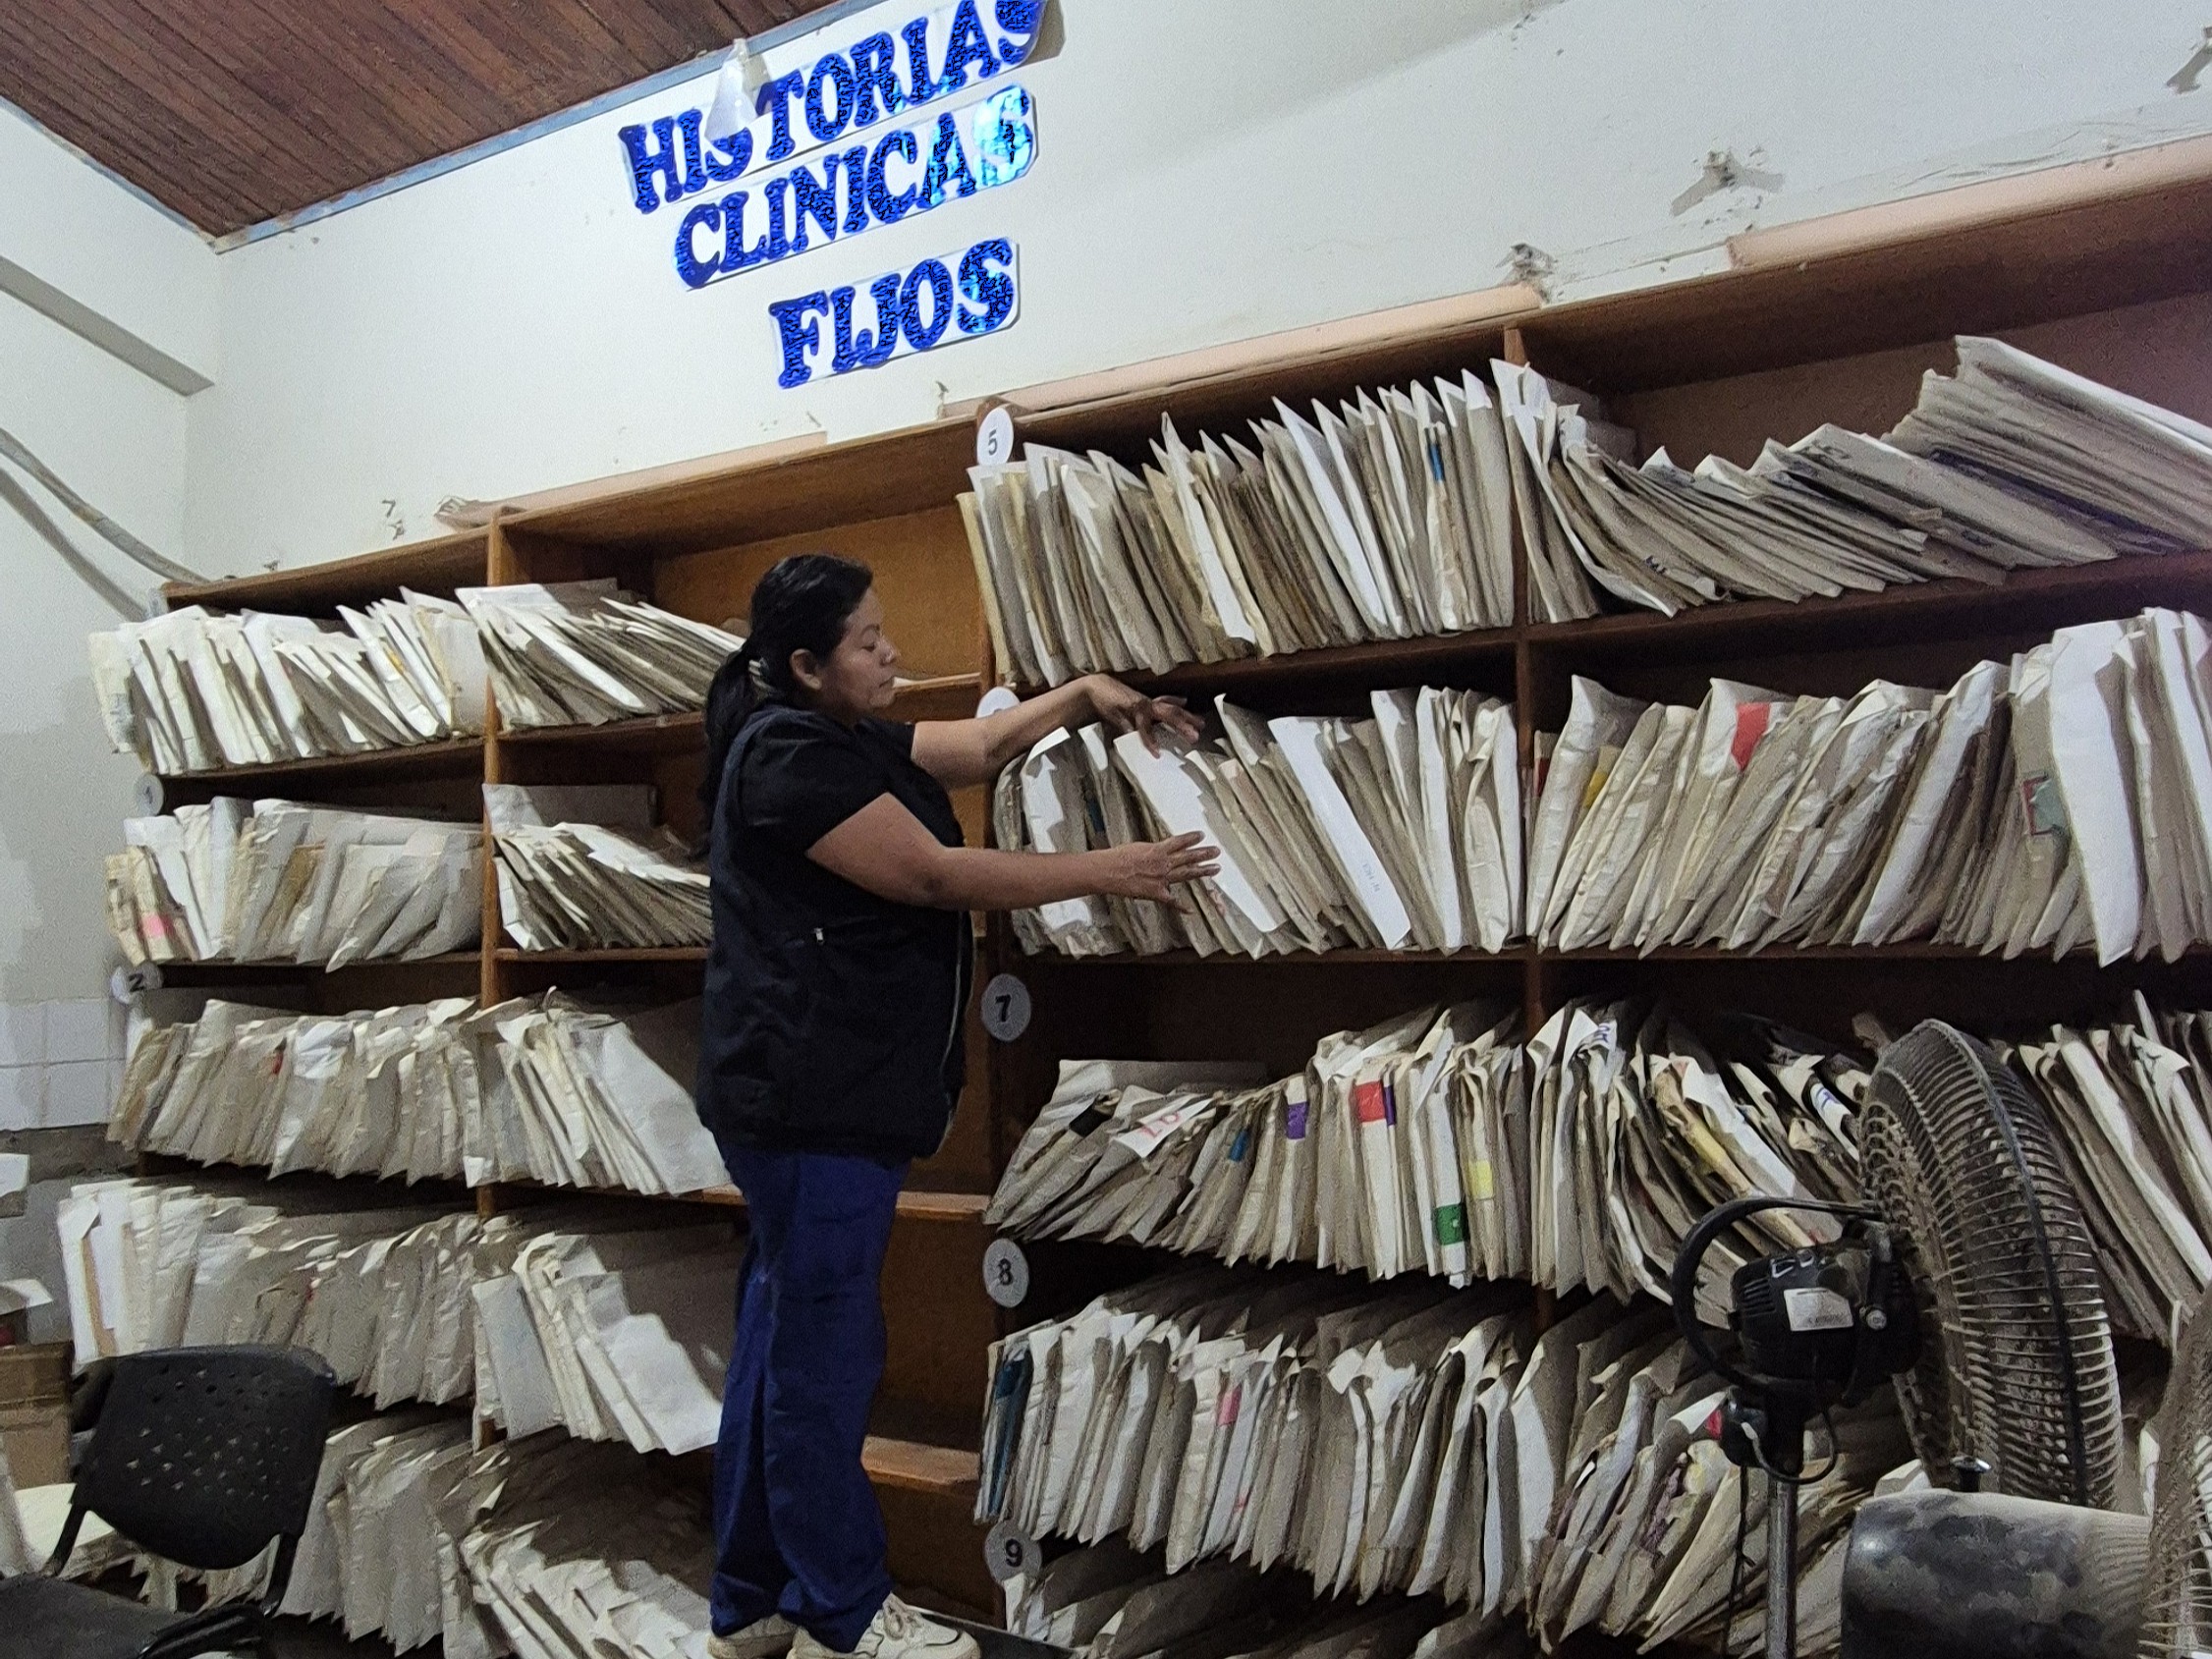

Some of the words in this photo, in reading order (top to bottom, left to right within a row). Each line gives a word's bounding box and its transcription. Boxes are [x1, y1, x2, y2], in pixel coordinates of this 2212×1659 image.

[673, 83, 1034, 289] CLINICAS
[768, 238, 1014, 390] FIJOS
[988, 429, 998, 456] 5
[129, 973, 145, 992] 2
[995, 994, 1012, 1023] 7
[998, 1258, 1014, 1286] 8
[1005, 1538, 1023, 1568] 9
